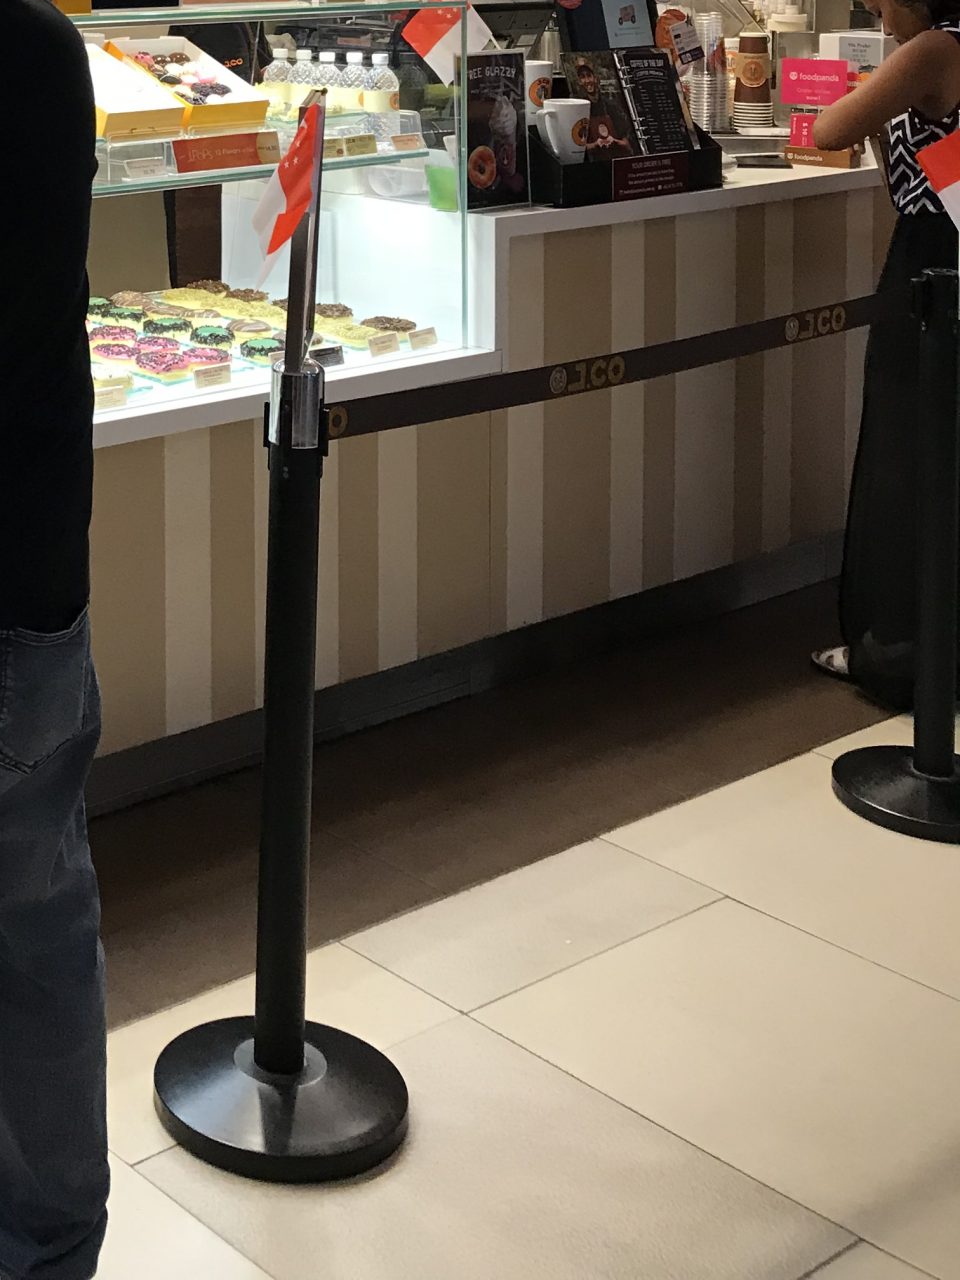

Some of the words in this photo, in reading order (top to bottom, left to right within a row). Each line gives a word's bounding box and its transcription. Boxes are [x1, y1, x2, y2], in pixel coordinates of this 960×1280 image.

[469, 67, 482, 80] REE
[485, 66, 516, 78] GLAZZY
[799, 72, 839, 82] foodpanda
[794, 154, 823, 162] foodpanda
[798, 306, 846, 339] J.CO
[568, 356, 625, 392] J.CO
